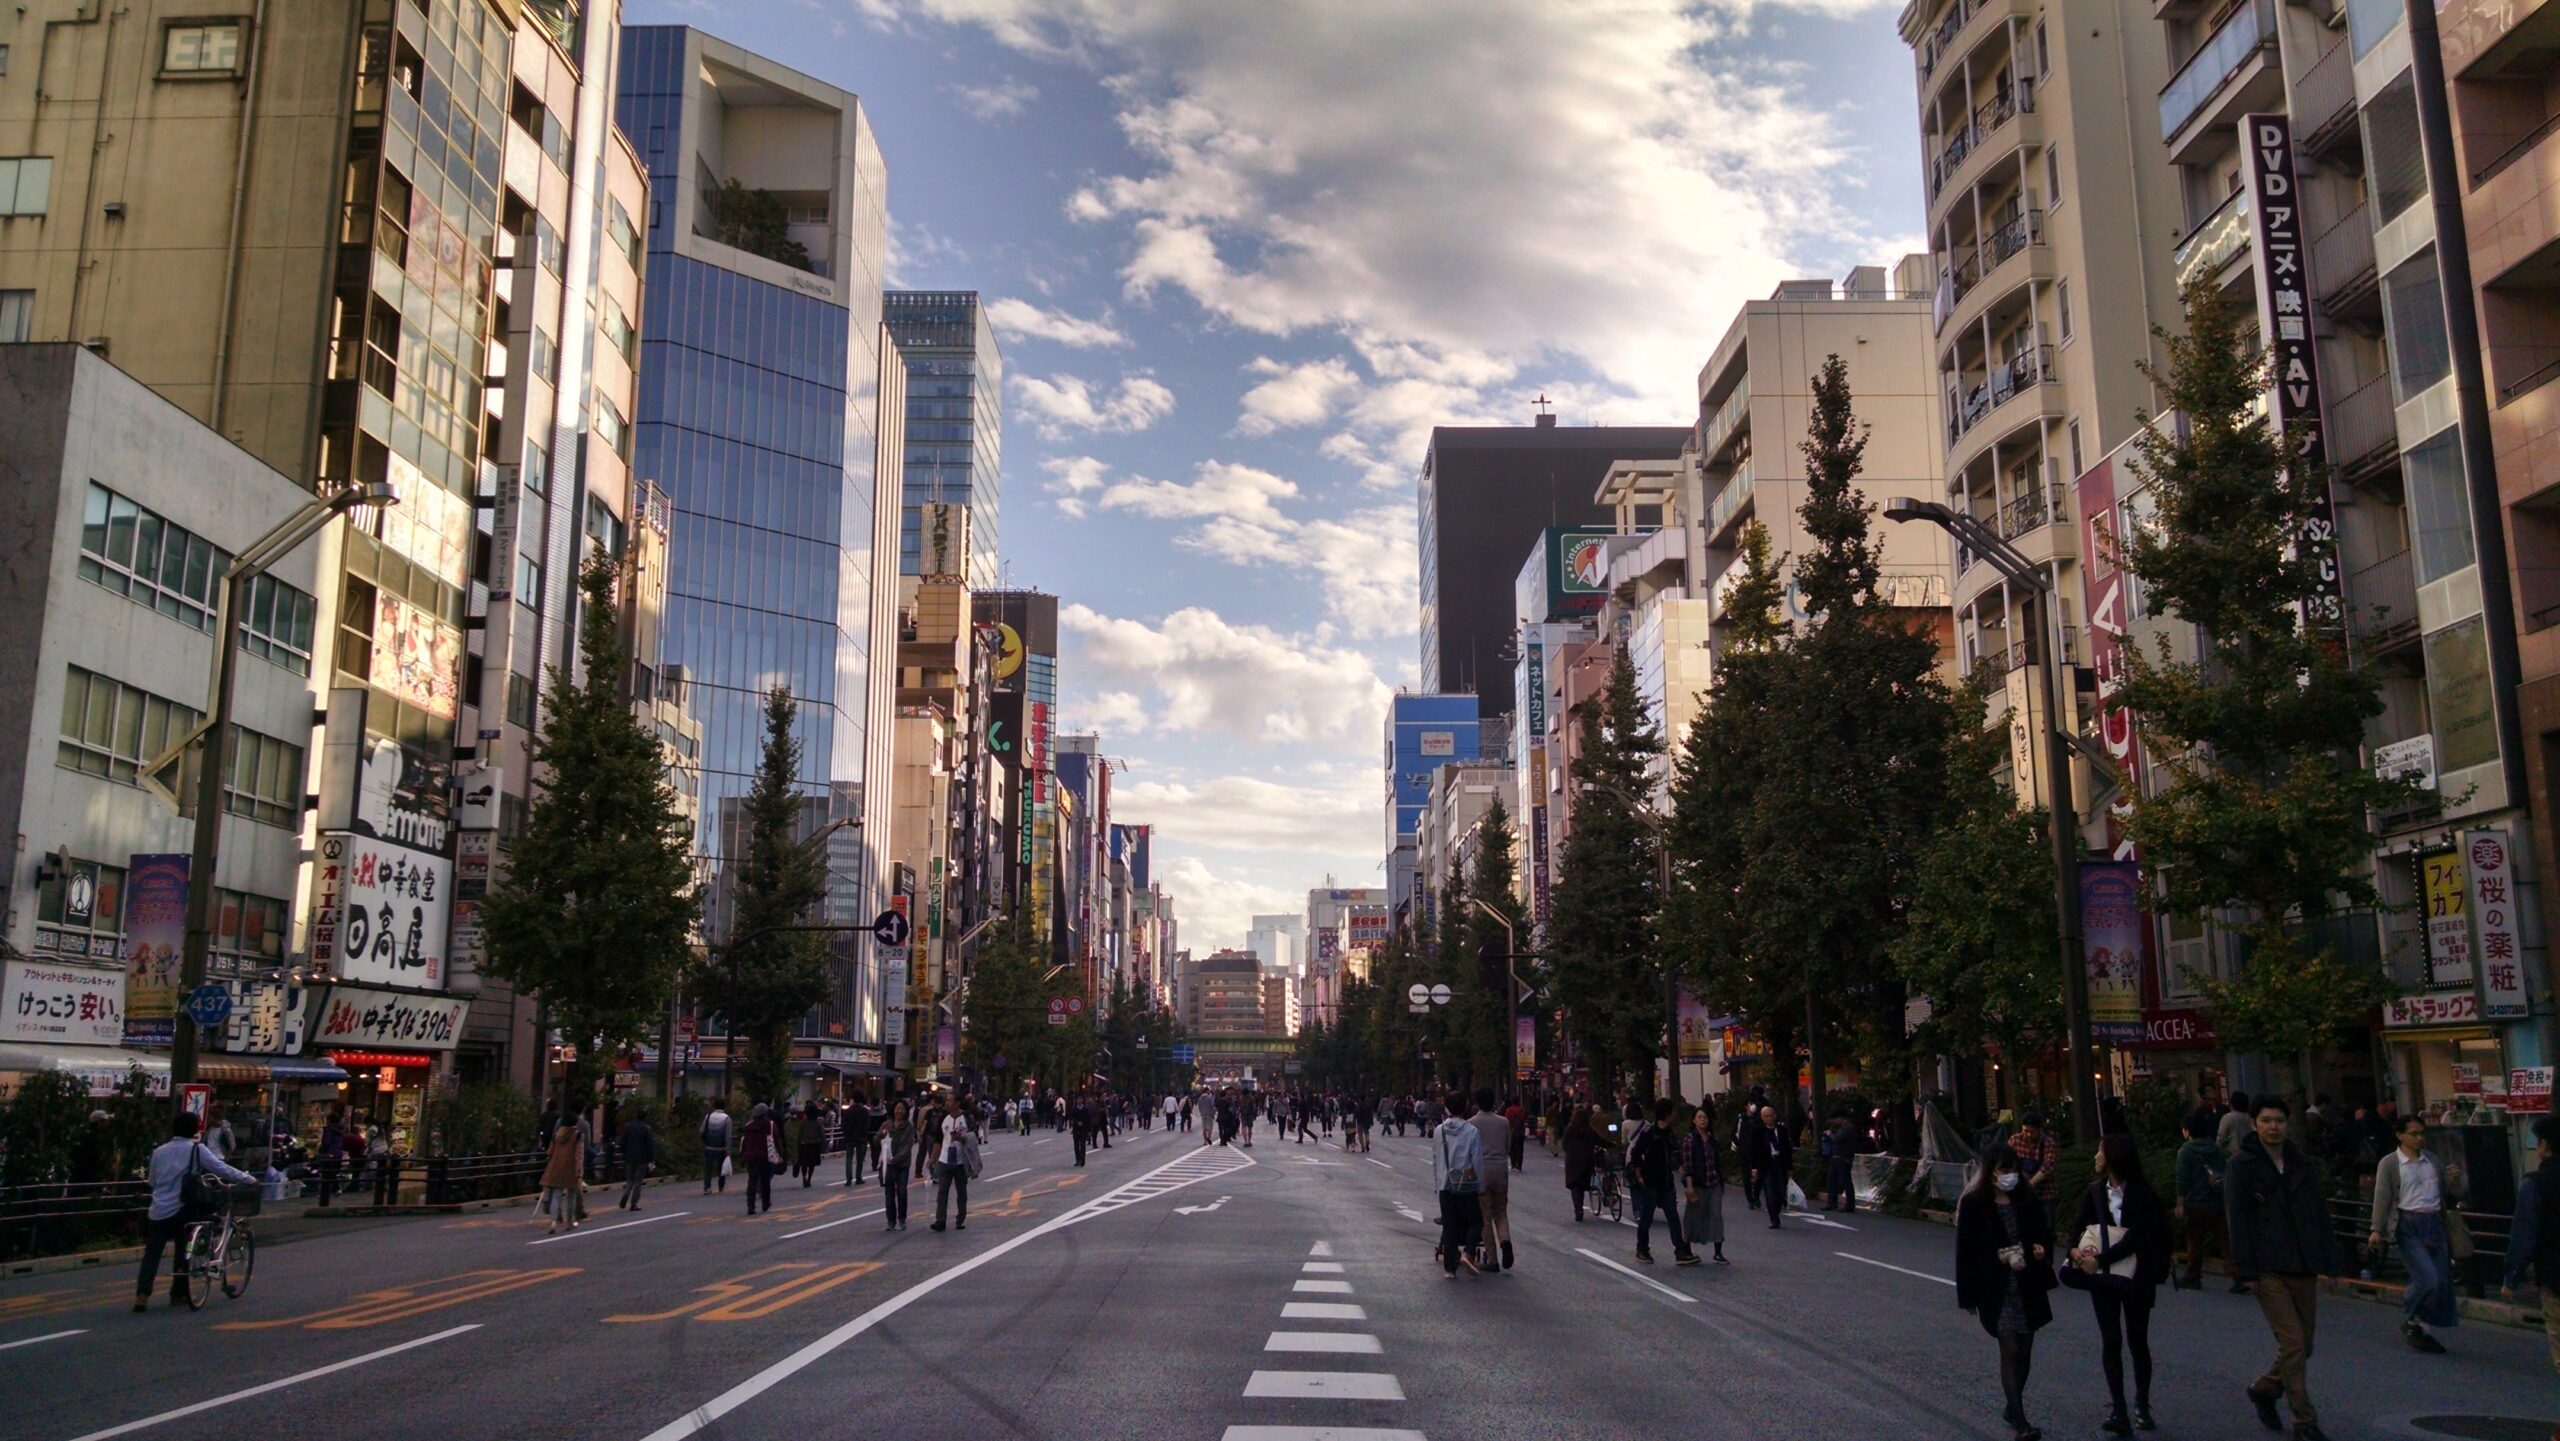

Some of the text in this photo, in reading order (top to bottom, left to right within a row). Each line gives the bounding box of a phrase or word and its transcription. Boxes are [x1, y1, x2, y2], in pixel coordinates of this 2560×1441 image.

[2258, 125, 2310, 409] DVD アニメ・映画・AV
[1530, 665, 1543, 731] ネットカフェ
[2014, 723, 2028, 781] ねぎし
[1022, 780, 1034, 865] TSUKUMO
[352, 852, 435, 903] 烈中華食堂
[931, 872, 942, 921] リバティー
[346, 900, 427, 972] 日高屋
[2477, 876, 2518, 992] 桜の薬粧
[17, 991, 120, 1023] けっこう安い。
[192, 995, 228, 1012] 437
[2146, 1018, 2191, 1041] ACCEA
